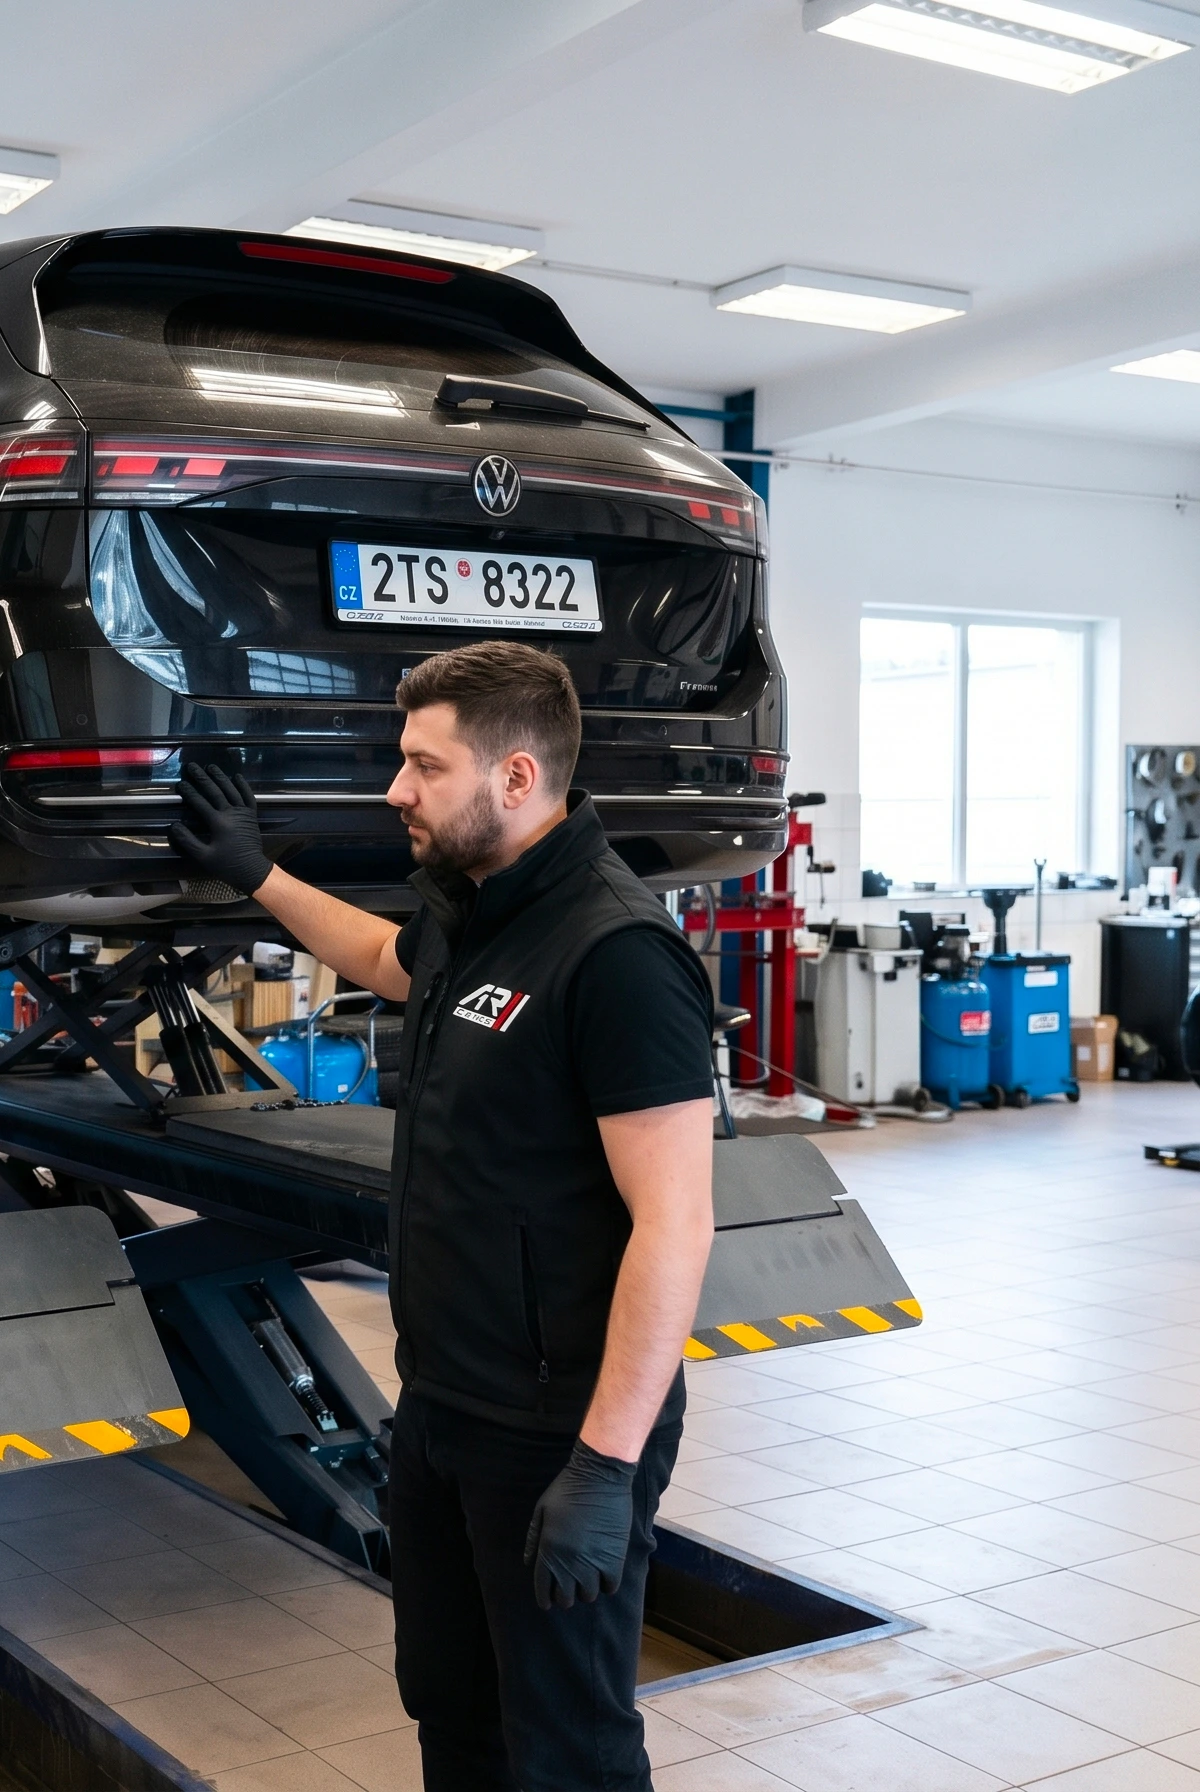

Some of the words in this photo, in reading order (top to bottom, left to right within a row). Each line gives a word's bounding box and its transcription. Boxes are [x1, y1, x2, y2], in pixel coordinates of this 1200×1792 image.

[475, 455, 520, 516] VW
[339, 586, 358, 601] CZ
[371, 552, 450, 605] 2TS
[482, 560, 579, 612] 8322
